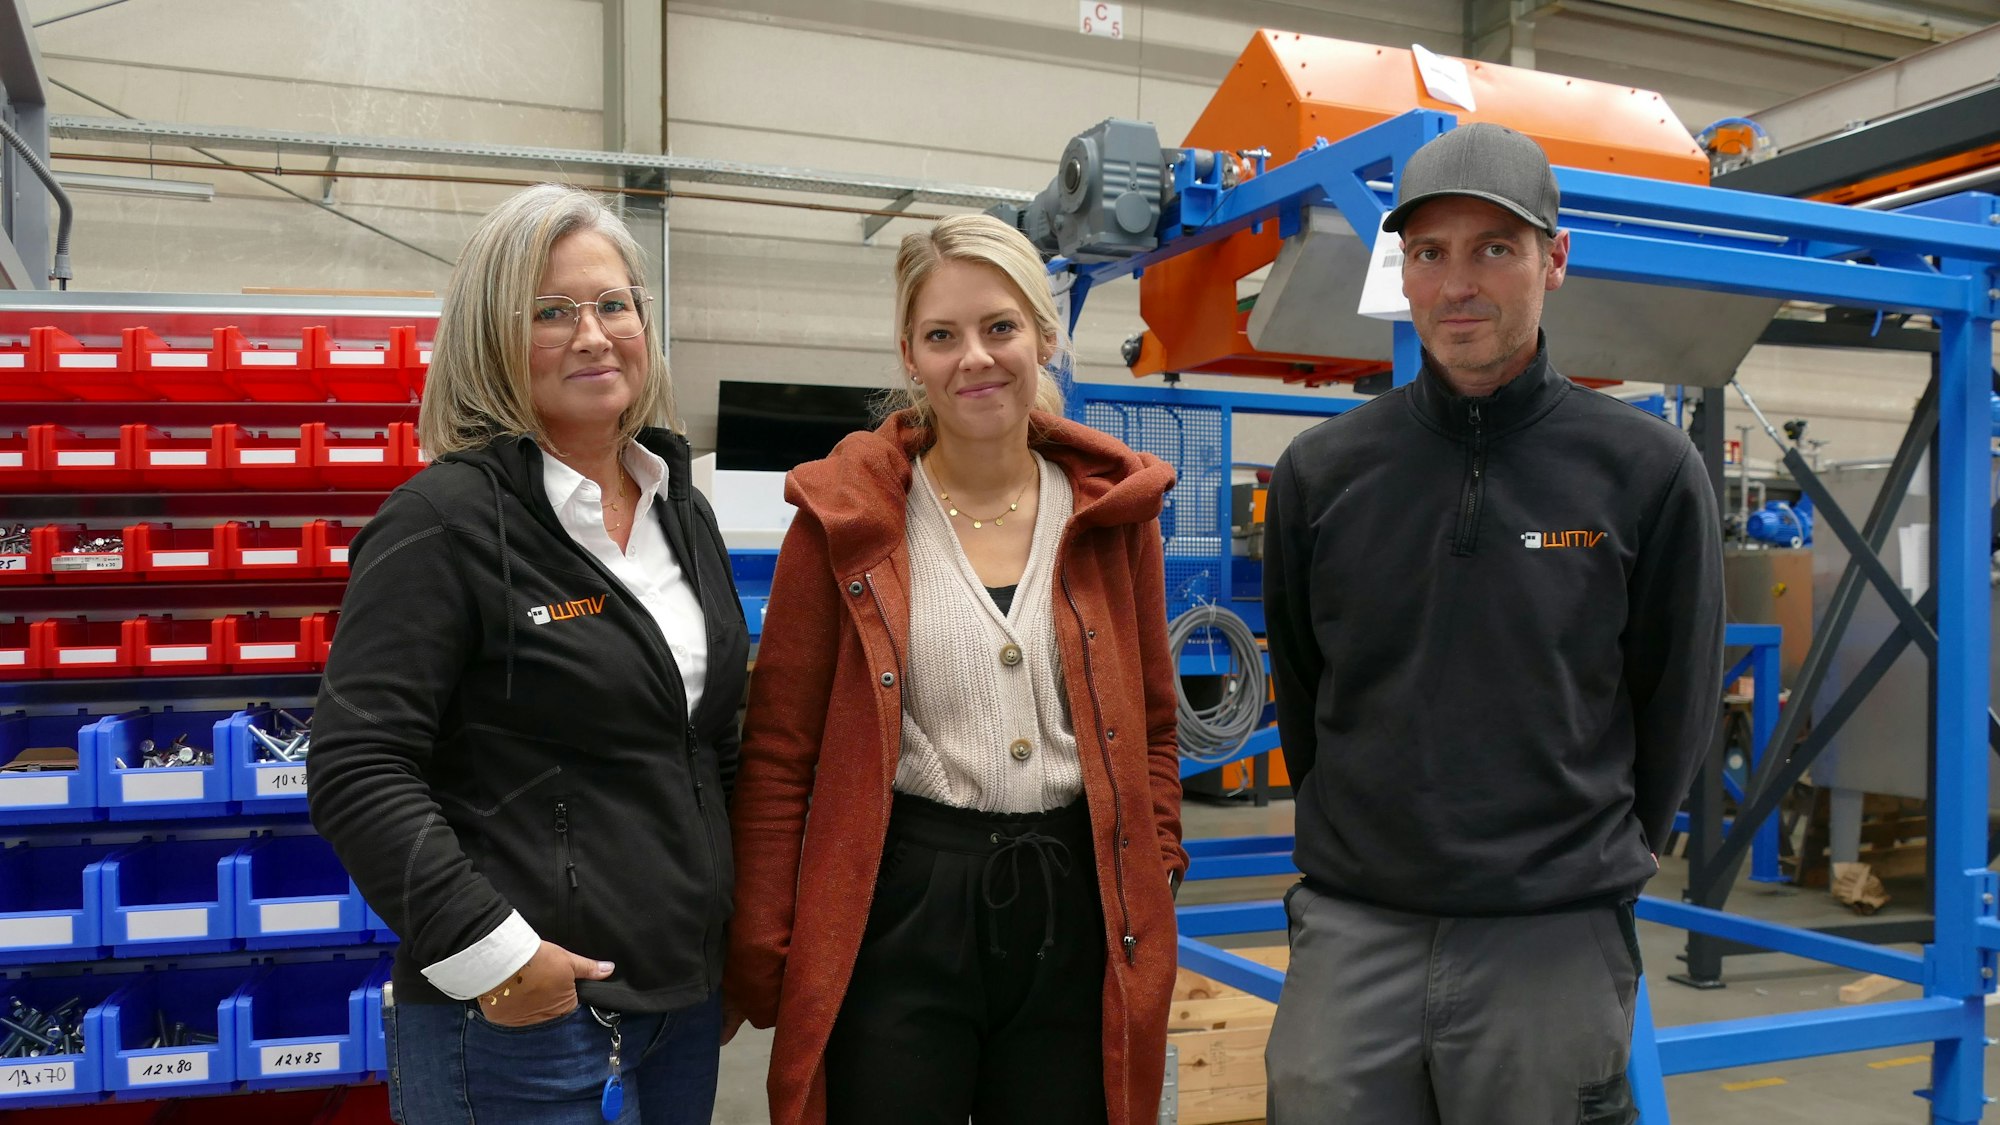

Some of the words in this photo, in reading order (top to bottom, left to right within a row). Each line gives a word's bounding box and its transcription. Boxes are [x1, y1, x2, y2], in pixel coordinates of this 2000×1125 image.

[1095, 3, 1107, 21] C
[1083, 16, 1092, 33] 6
[1112, 21, 1120, 38] 5
